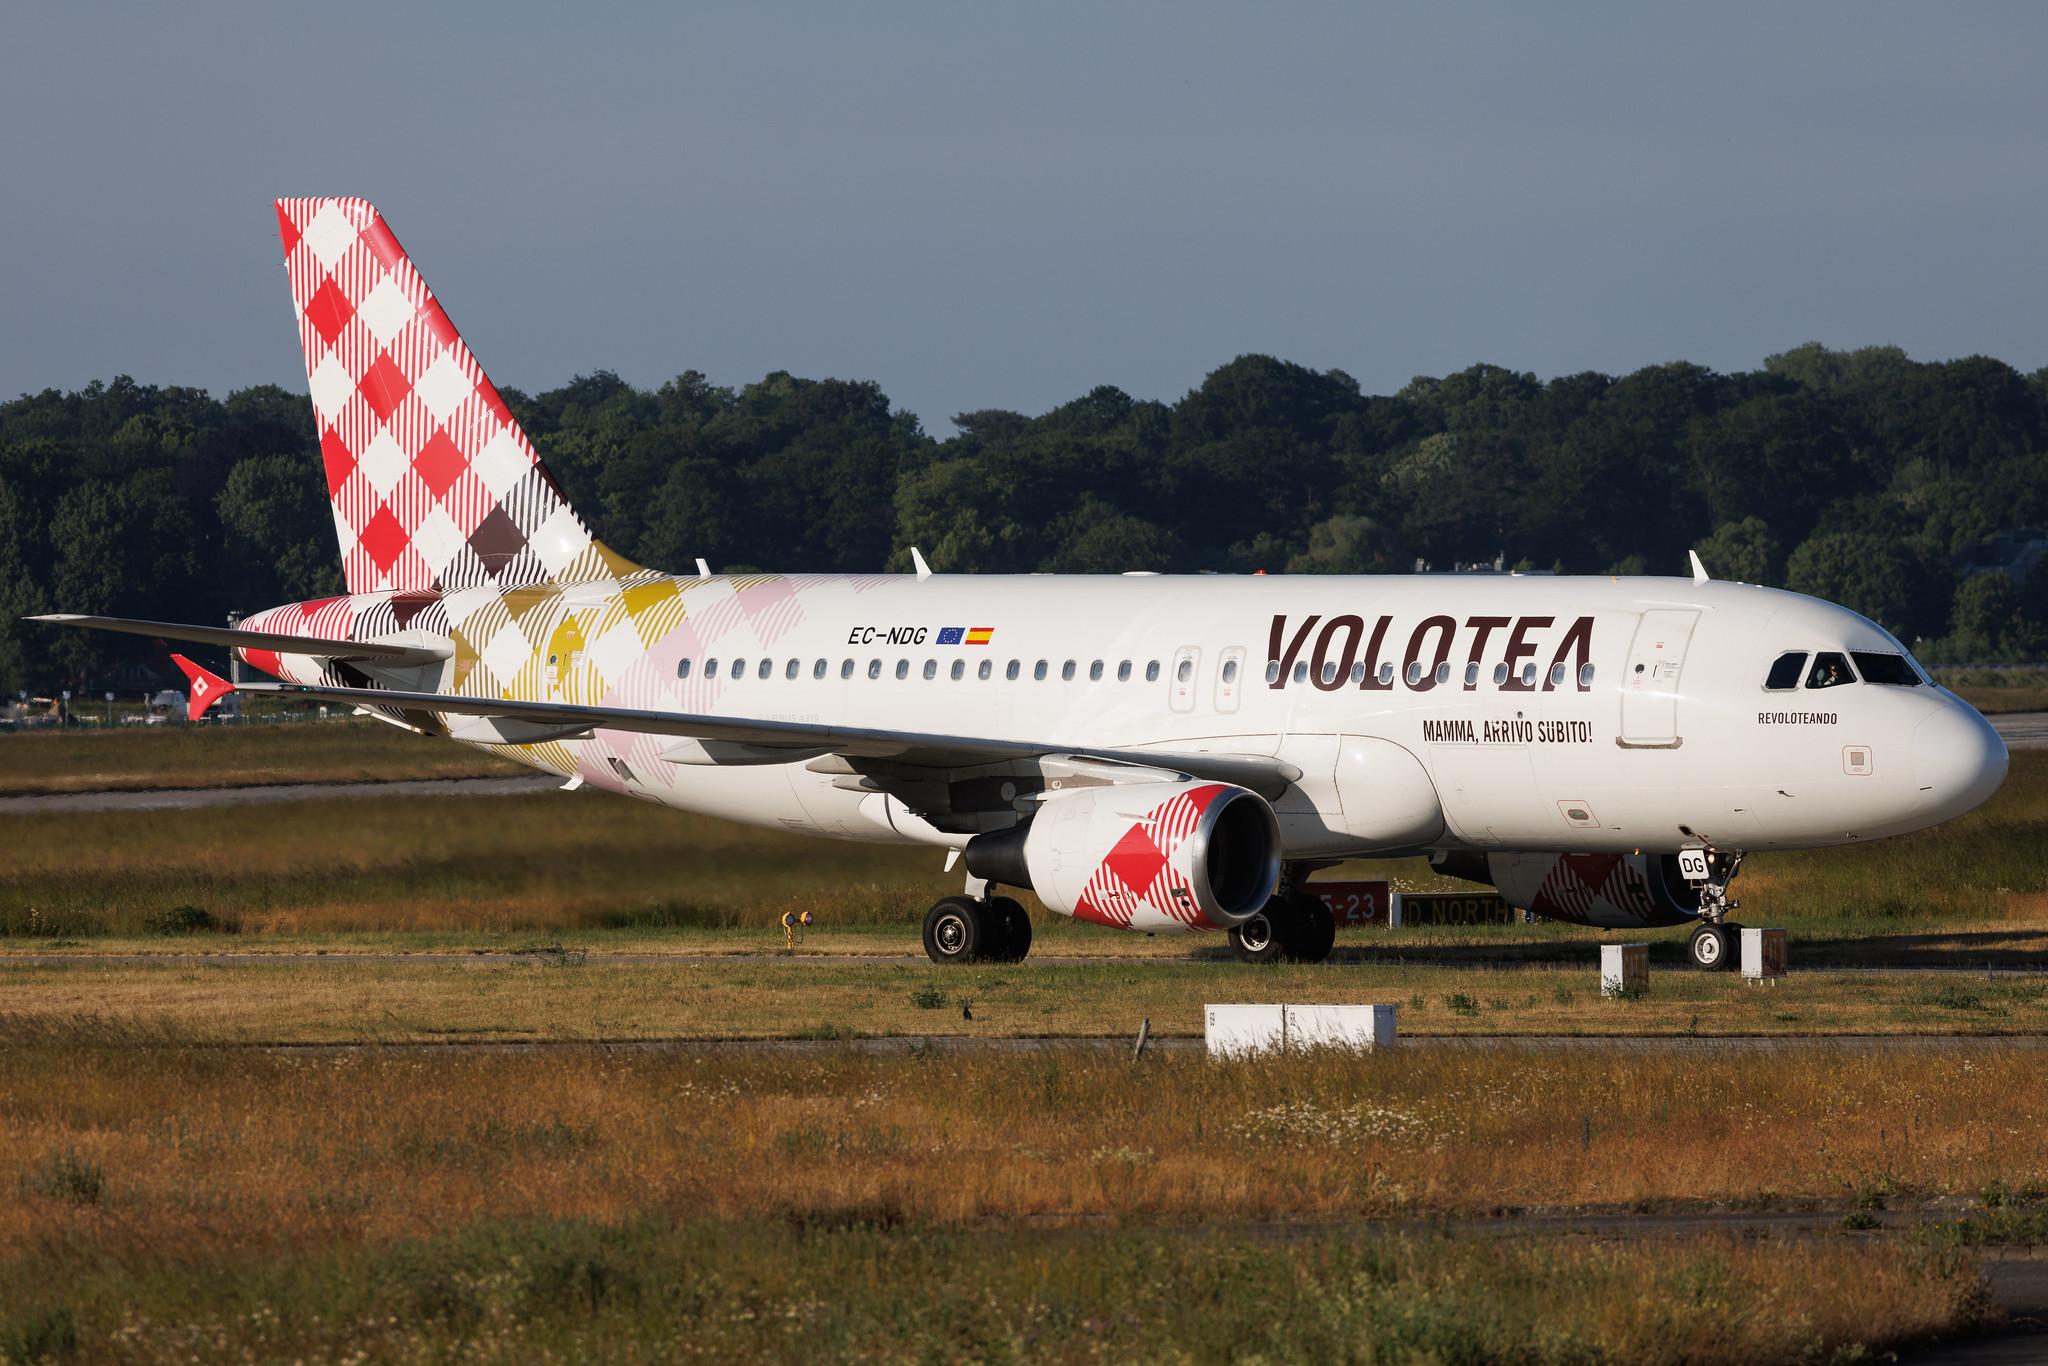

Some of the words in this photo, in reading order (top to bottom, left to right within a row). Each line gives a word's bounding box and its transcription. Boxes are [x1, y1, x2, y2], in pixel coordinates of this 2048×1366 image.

[848, 626, 928, 645] EC-NDG
[1266, 614, 1595, 692] VOLOTEA
[1758, 712, 1838, 725] REVOLOTEANDO
[1423, 719, 1479, 744] MAMMA,
[1484, 720, 1533, 743] ARRIVO
[1538, 720, 1593, 743] SUBITO!
[1682, 858, 1704, 872] DG
[1432, 898, 1509, 924] NORTH
